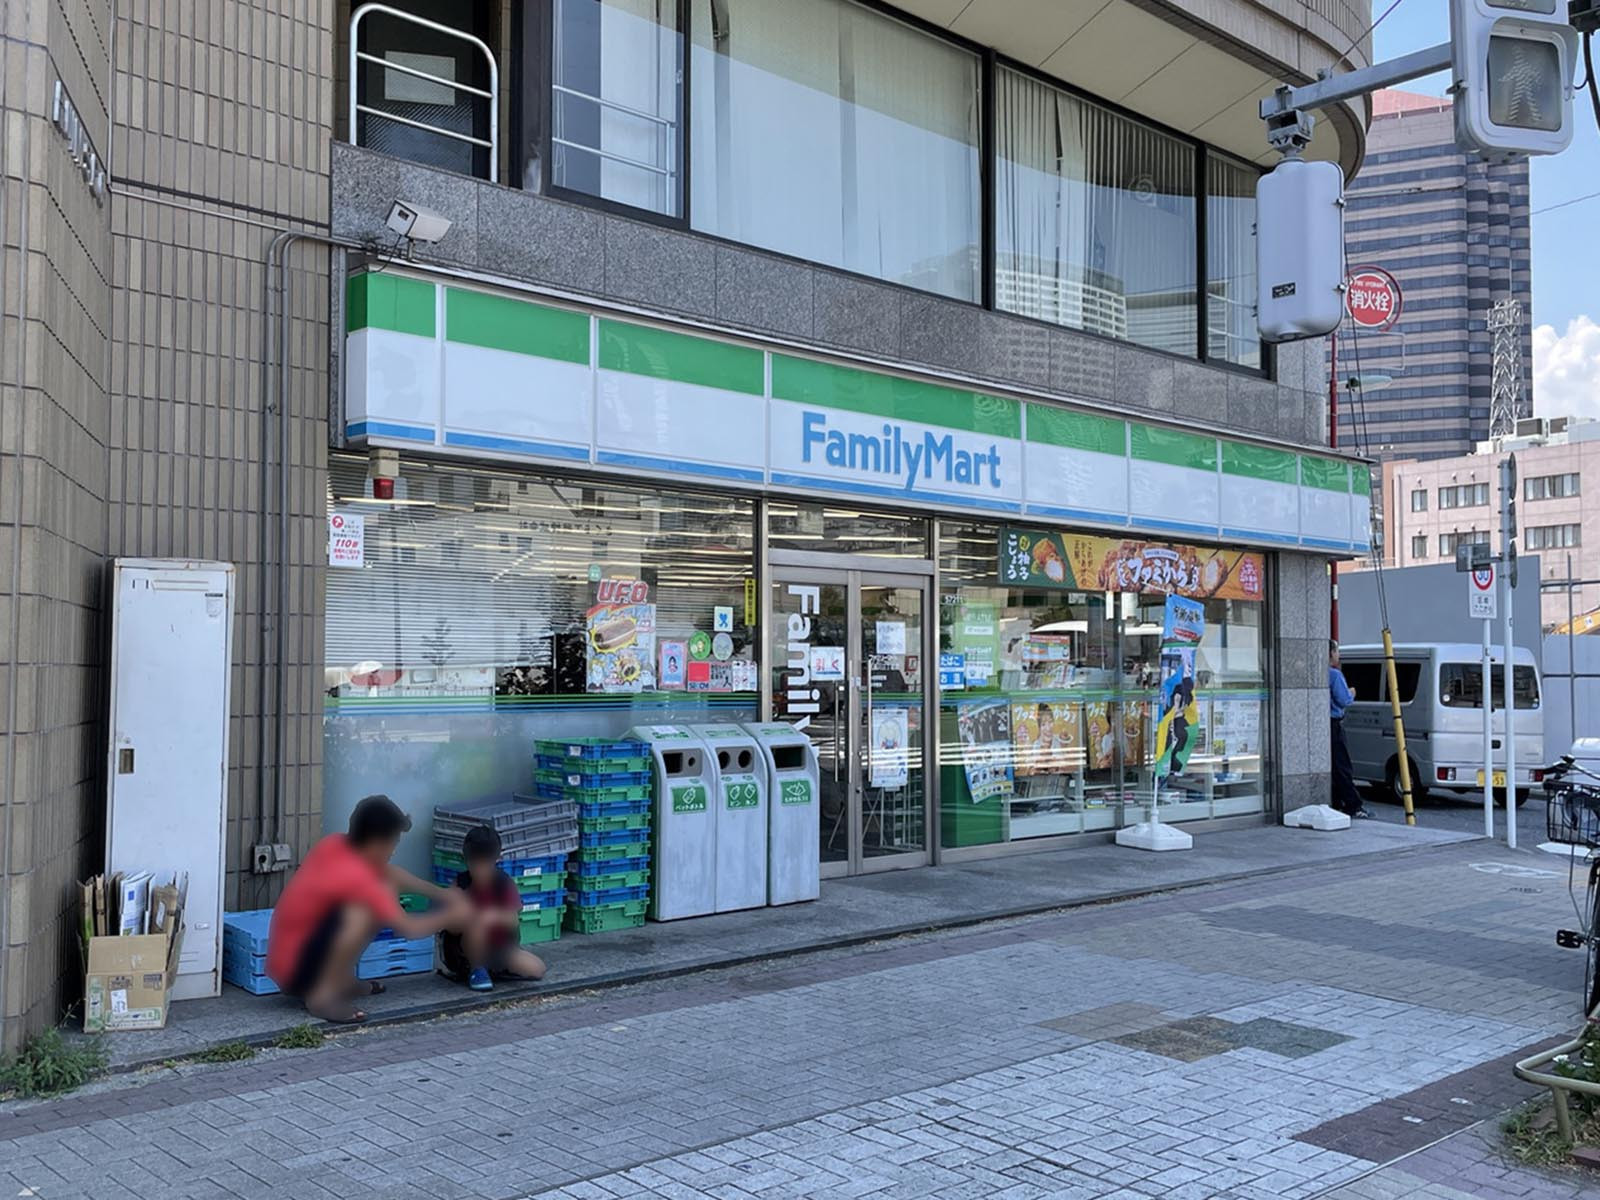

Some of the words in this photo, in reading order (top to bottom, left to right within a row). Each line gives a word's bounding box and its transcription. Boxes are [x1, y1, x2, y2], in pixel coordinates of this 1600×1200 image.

[1350, 290, 1389, 311] 消火栓
[802, 411, 1001, 491] FamilyMart
[940, 655, 960, 666] たばこ
